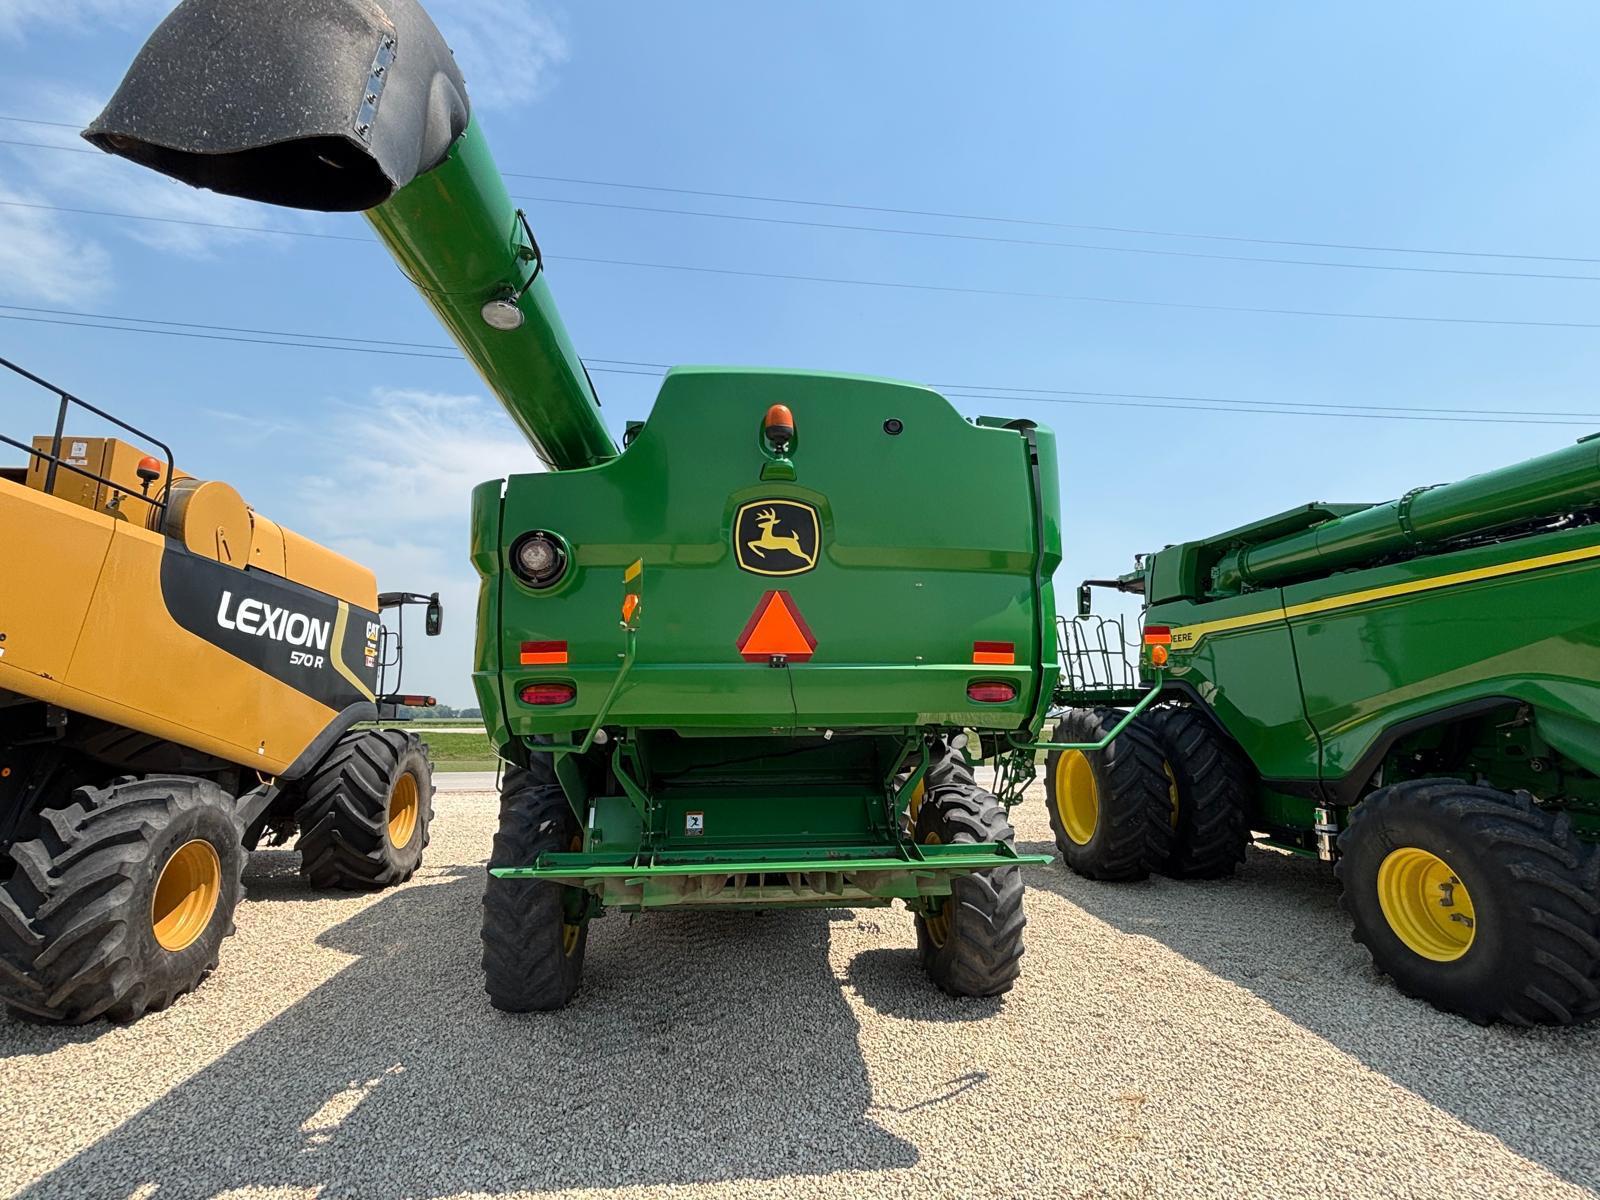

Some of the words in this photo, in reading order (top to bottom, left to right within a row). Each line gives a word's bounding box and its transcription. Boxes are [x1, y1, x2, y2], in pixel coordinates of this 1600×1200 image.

[217, 590, 331, 651] LEXION
[366, 621, 380, 641] CAT
[289, 651, 313, 667] 570
[314, 655, 324, 669] R
